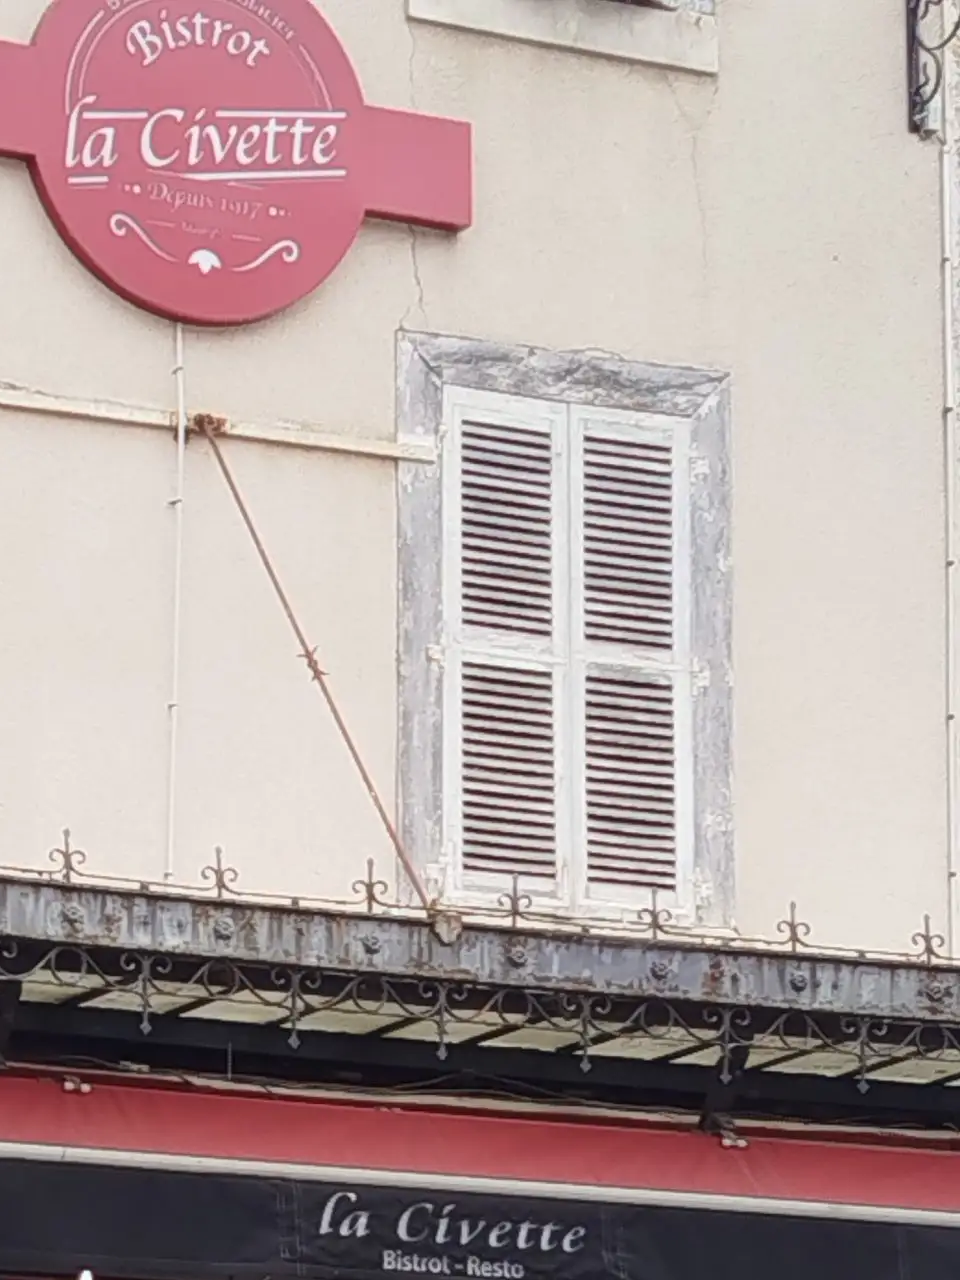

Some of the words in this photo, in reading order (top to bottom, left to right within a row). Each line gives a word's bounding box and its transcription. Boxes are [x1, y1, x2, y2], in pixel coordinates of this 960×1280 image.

[126, 9, 271, 67] Bistrot
[65, 95, 118, 168] la
[141, 108, 338, 168] Civette
[396, 1202, 587, 1253] Civette
[382, 1250, 451, 1275] Bistrot
[466, 1255, 525, 1279] Resto
